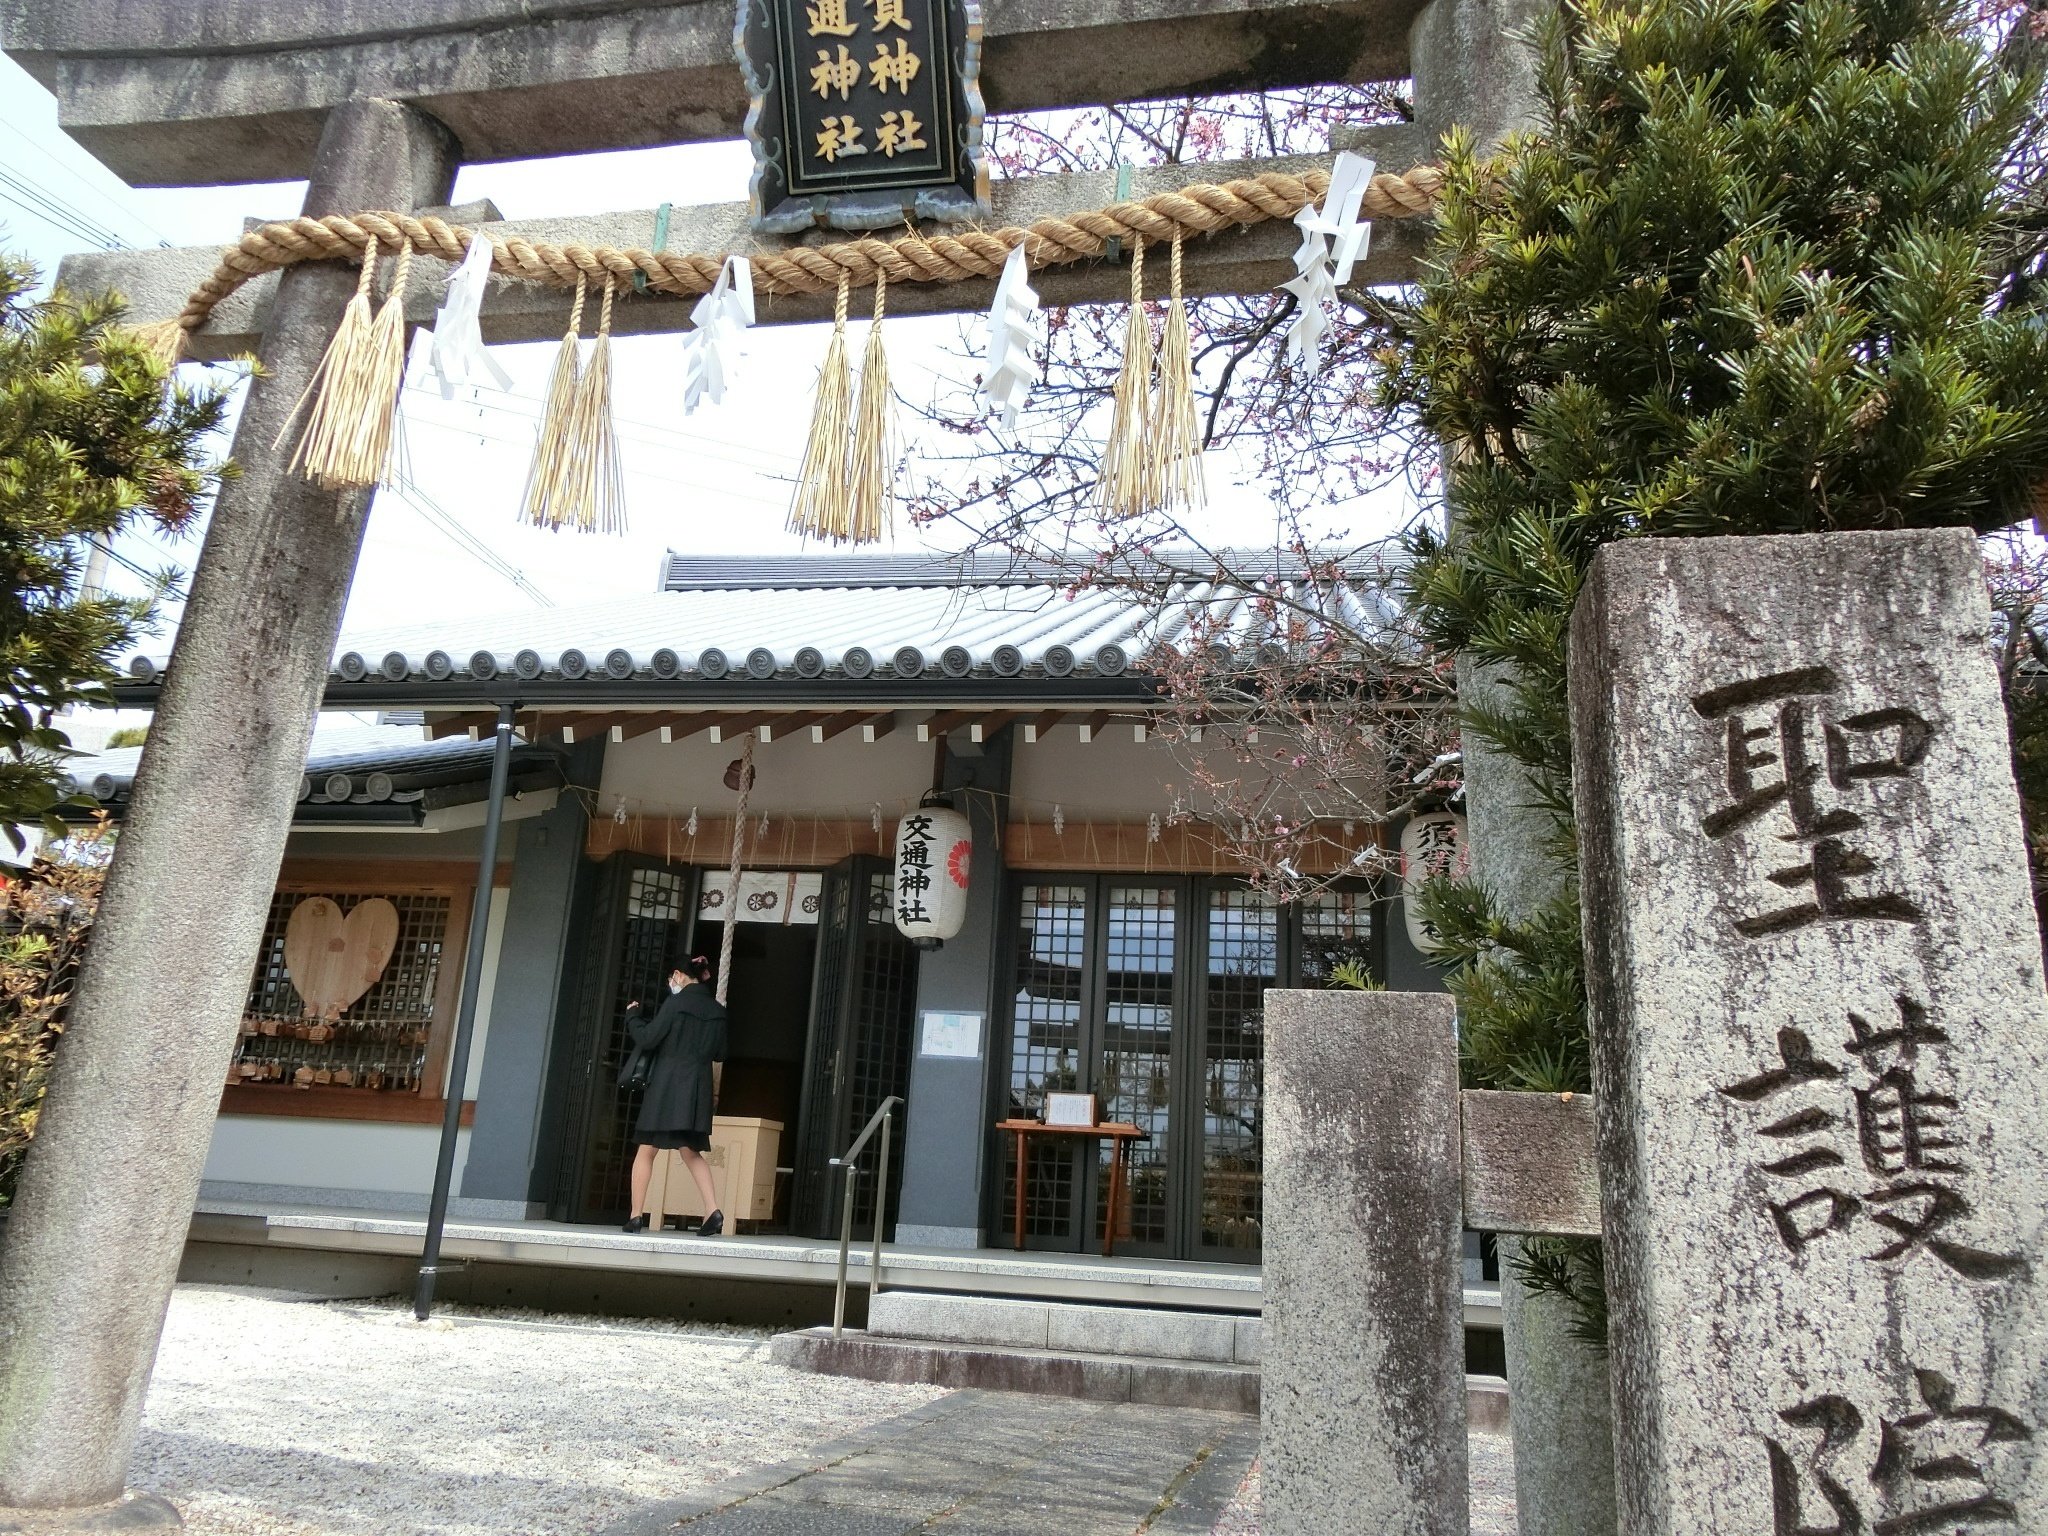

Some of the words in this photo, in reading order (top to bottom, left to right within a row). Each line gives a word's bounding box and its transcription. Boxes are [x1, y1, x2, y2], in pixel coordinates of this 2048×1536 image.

[806, 0, 868, 163] 通神社
[898, 814, 937, 927] 交通神社
